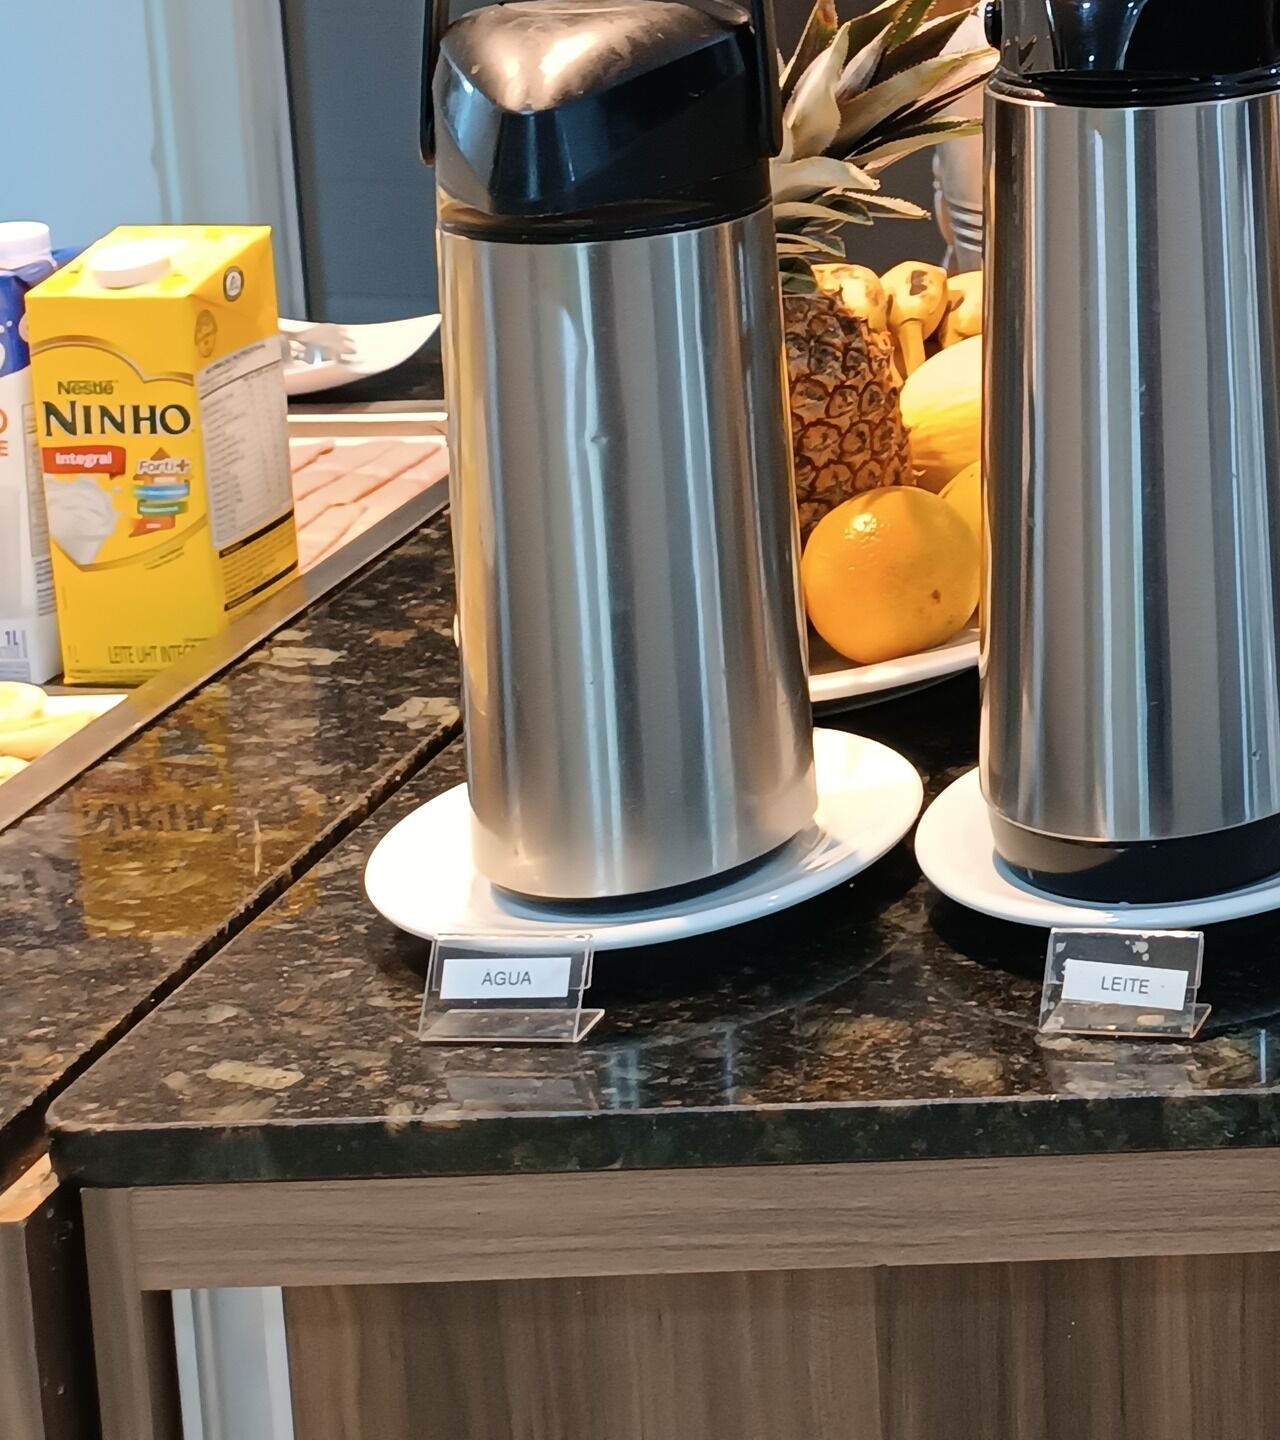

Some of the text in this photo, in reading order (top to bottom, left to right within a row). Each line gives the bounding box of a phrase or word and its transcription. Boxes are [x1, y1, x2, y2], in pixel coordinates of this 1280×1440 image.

[42, 400, 191, 437] NINHO
[55, 451, 113, 468] Integral
[1101, 975, 1150, 995] LEITE
